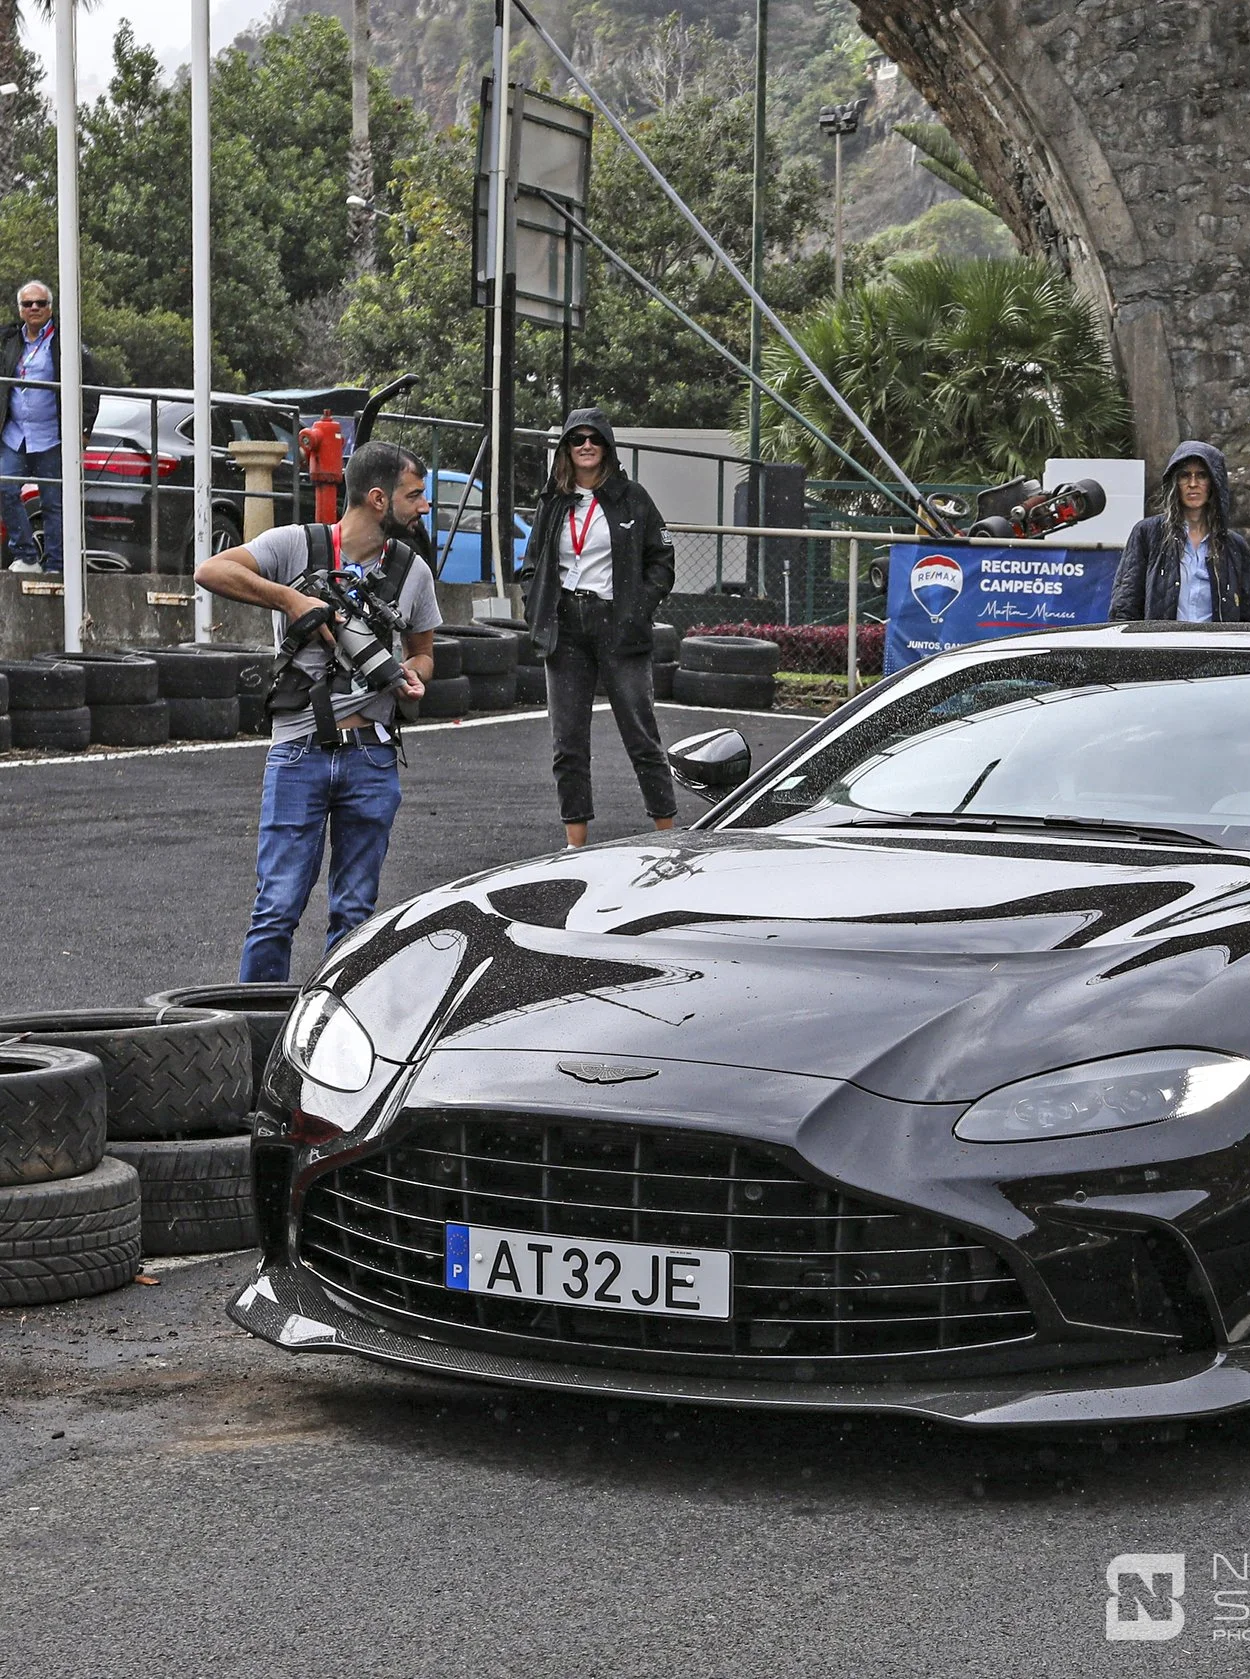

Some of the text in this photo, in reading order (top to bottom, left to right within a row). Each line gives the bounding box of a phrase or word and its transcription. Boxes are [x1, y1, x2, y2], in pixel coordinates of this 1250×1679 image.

[981, 560, 1084, 577] RECRUTAMOS
[918, 571, 957, 583] RE/MAX
[980, 578, 1063, 595] CAMPEÕES
[907, 640, 942, 650] JUNTOS,
[453, 1264, 463, 1278] P
